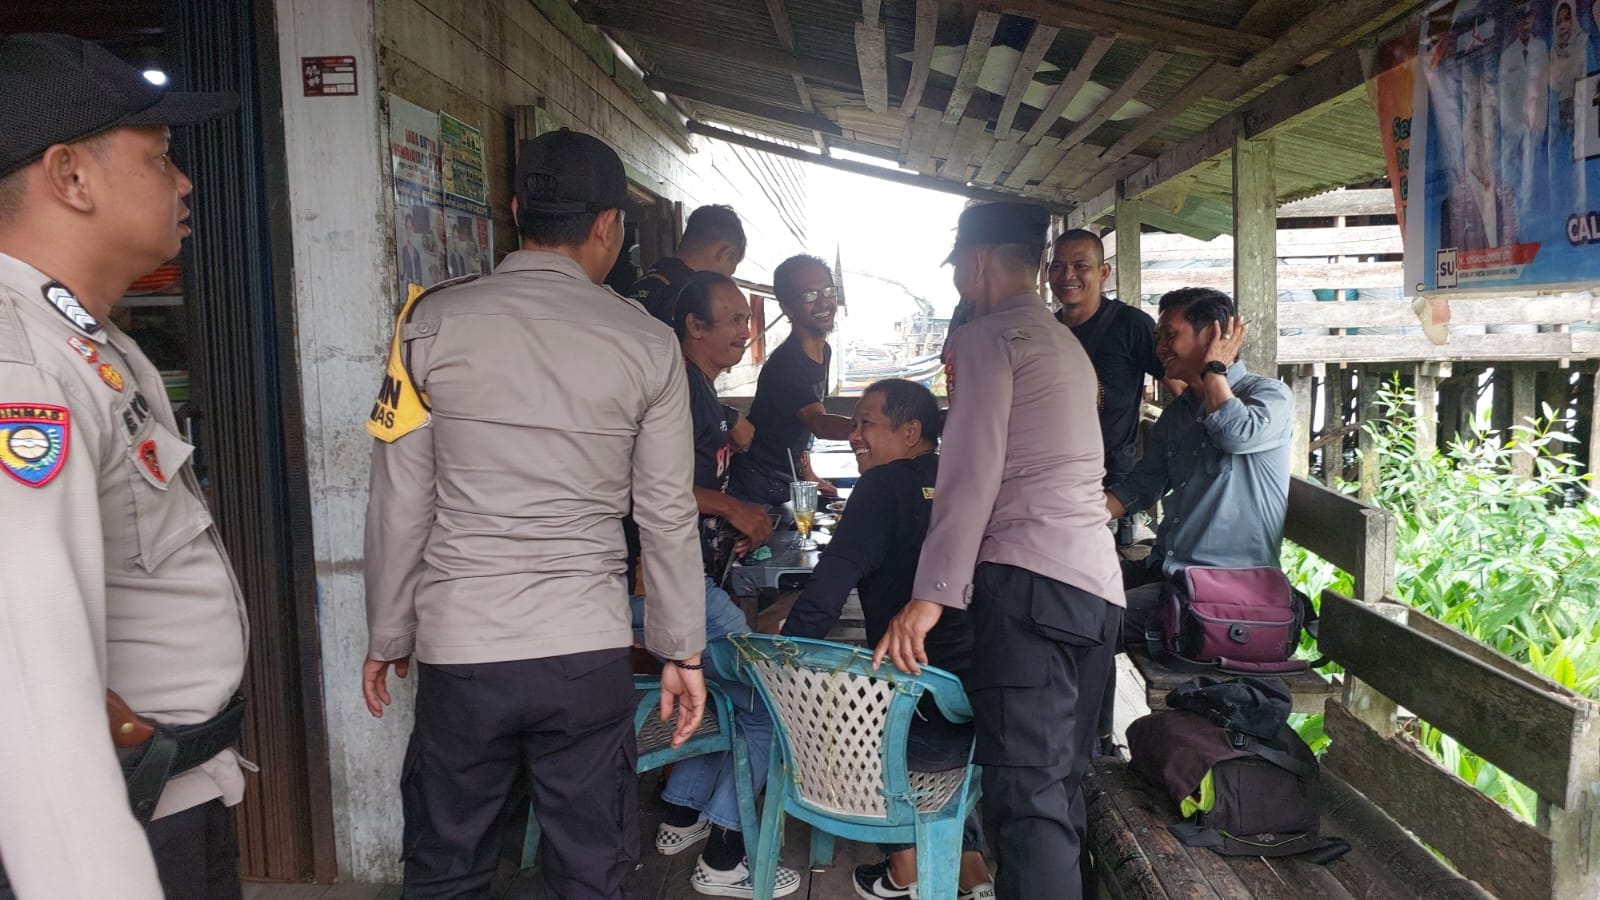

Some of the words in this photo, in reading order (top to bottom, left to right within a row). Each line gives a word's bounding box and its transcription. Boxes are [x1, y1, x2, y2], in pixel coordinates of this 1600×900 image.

[1440, 261, 1455, 277] SU
[0, 408, 60, 420] INMAS
[122, 391, 149, 436] EKO
